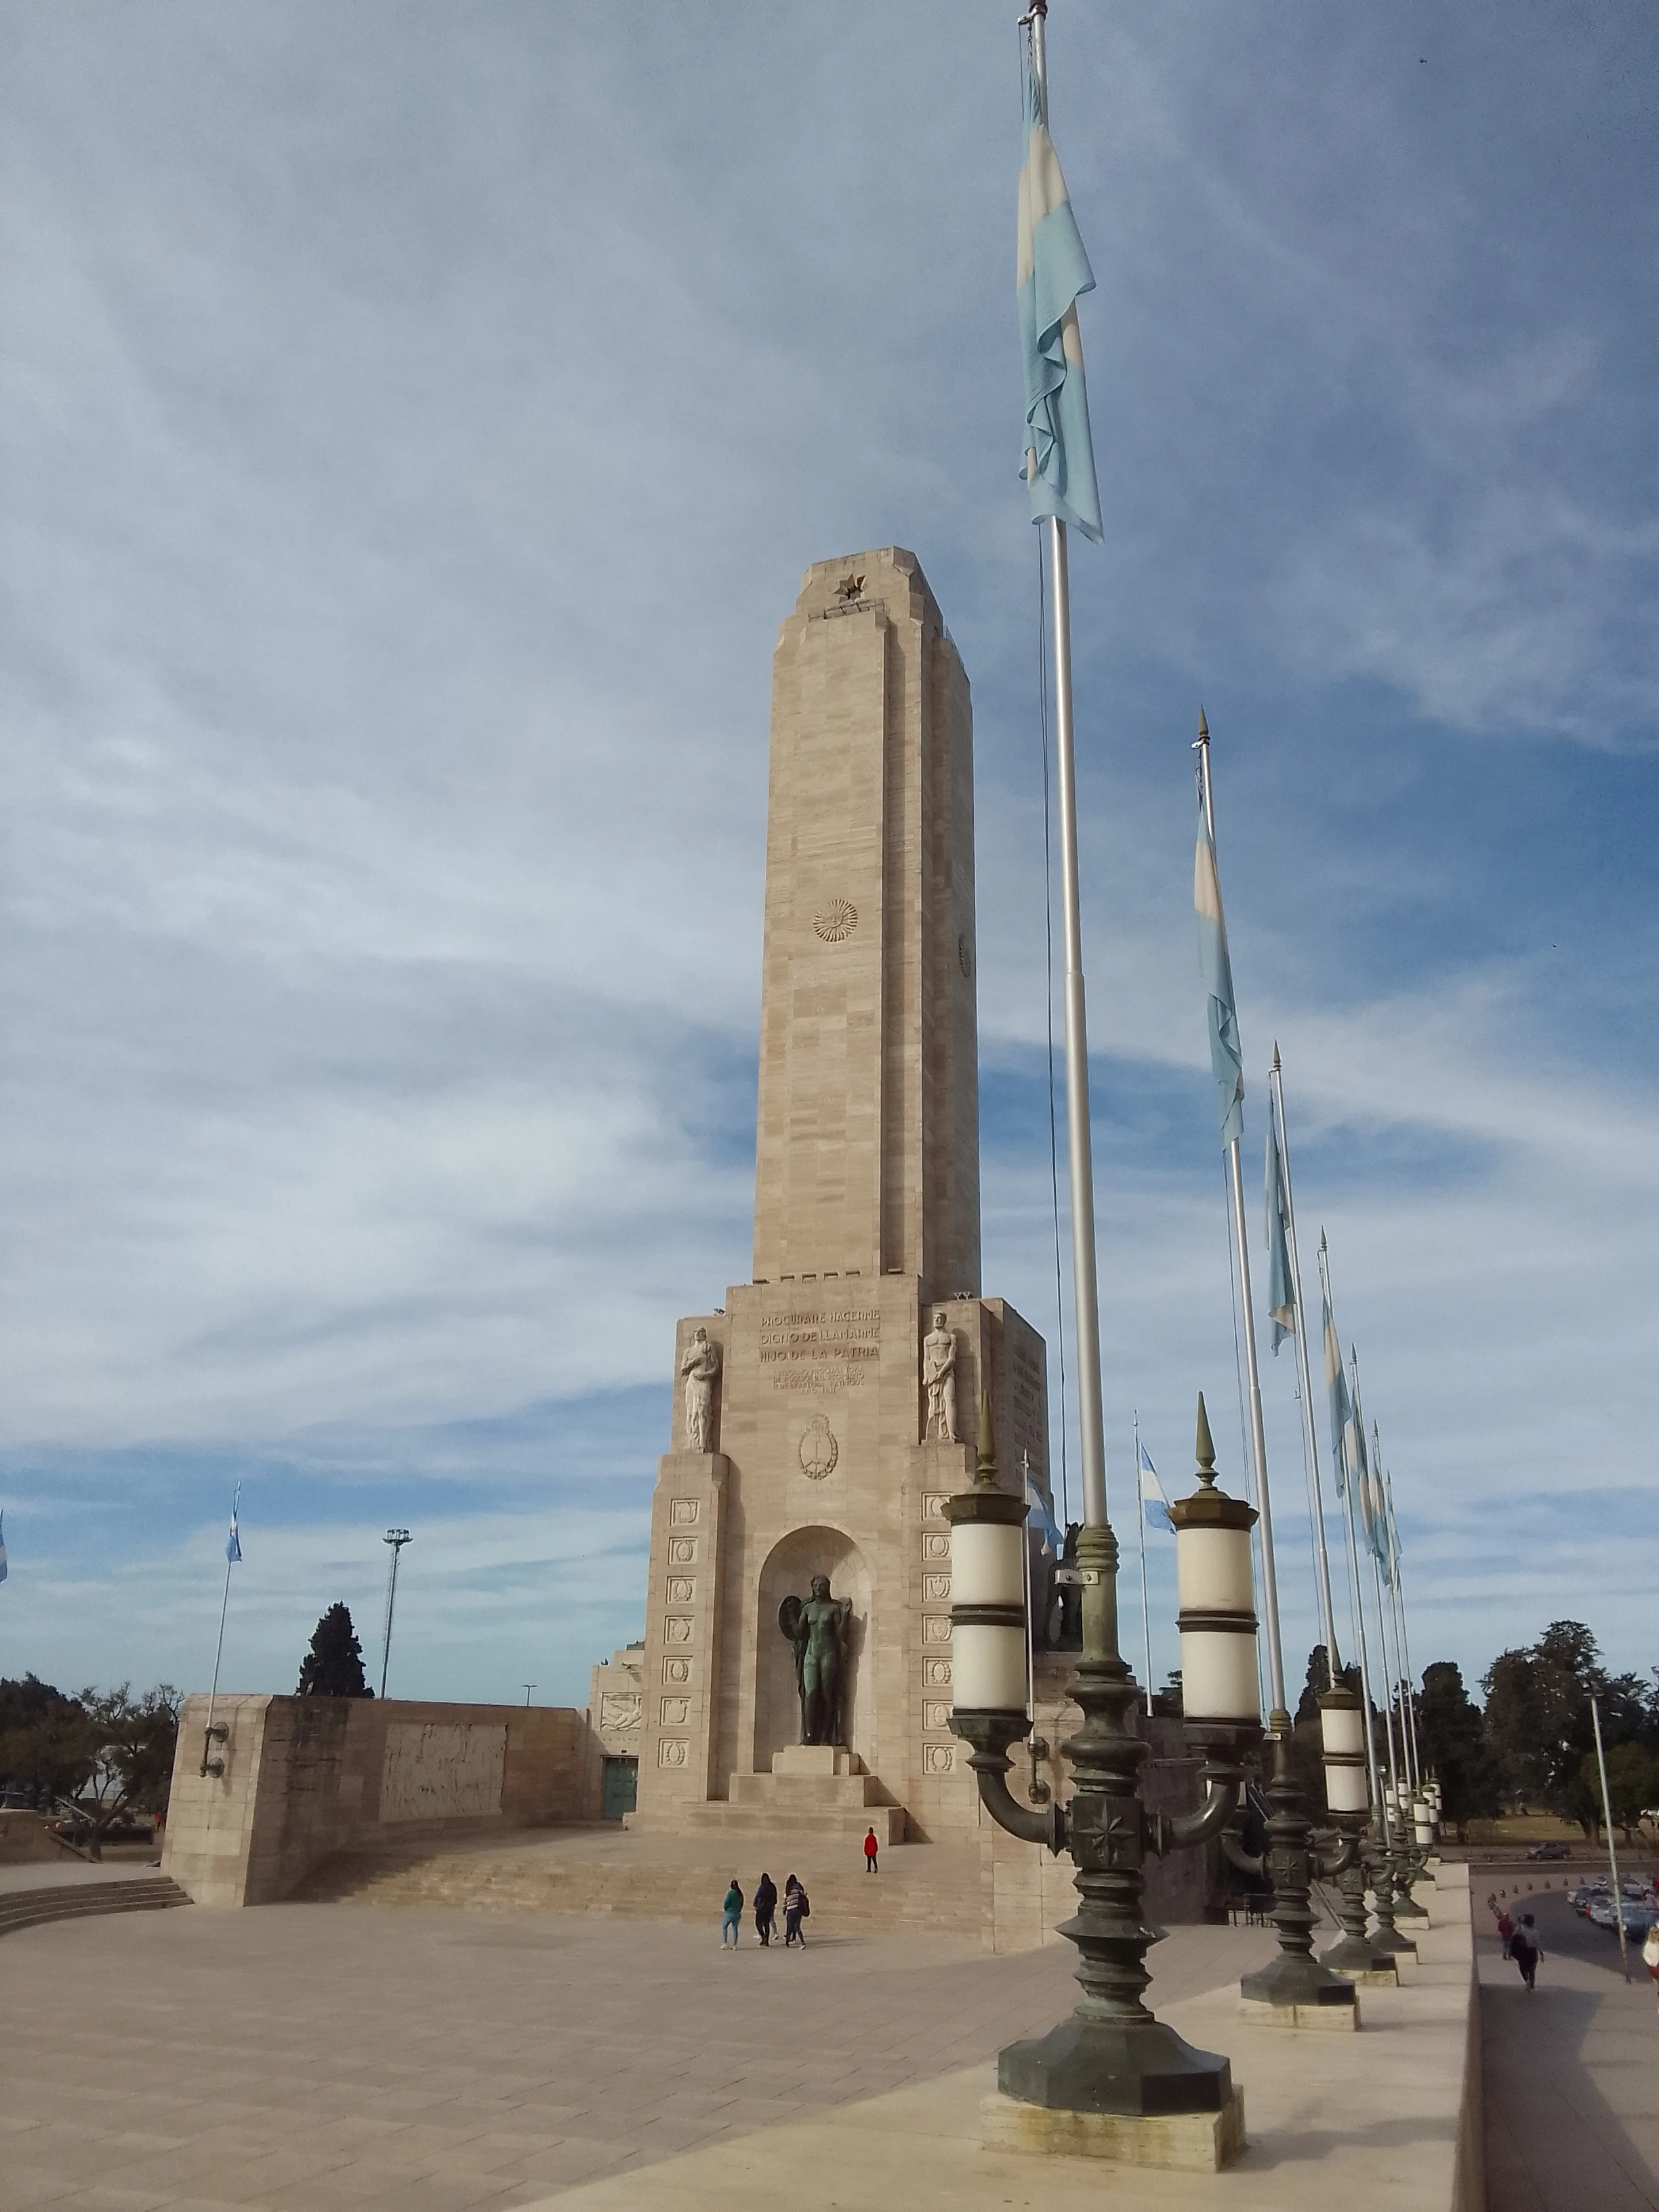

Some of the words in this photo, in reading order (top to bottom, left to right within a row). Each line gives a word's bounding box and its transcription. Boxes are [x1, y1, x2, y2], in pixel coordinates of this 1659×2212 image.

[830, 1309, 880, 1323] HACERME
[760, 1332, 800, 1345] DIGNO
[802, 1331, 817, 1343] DE
[819, 1328, 880, 1341] LLAMARME
[760, 1350, 787, 1363] HIJO
[791, 1349, 806, 1361] DE
[812, 1349, 828, 1360] LA
[834, 1345, 879, 1359] PATRIA
